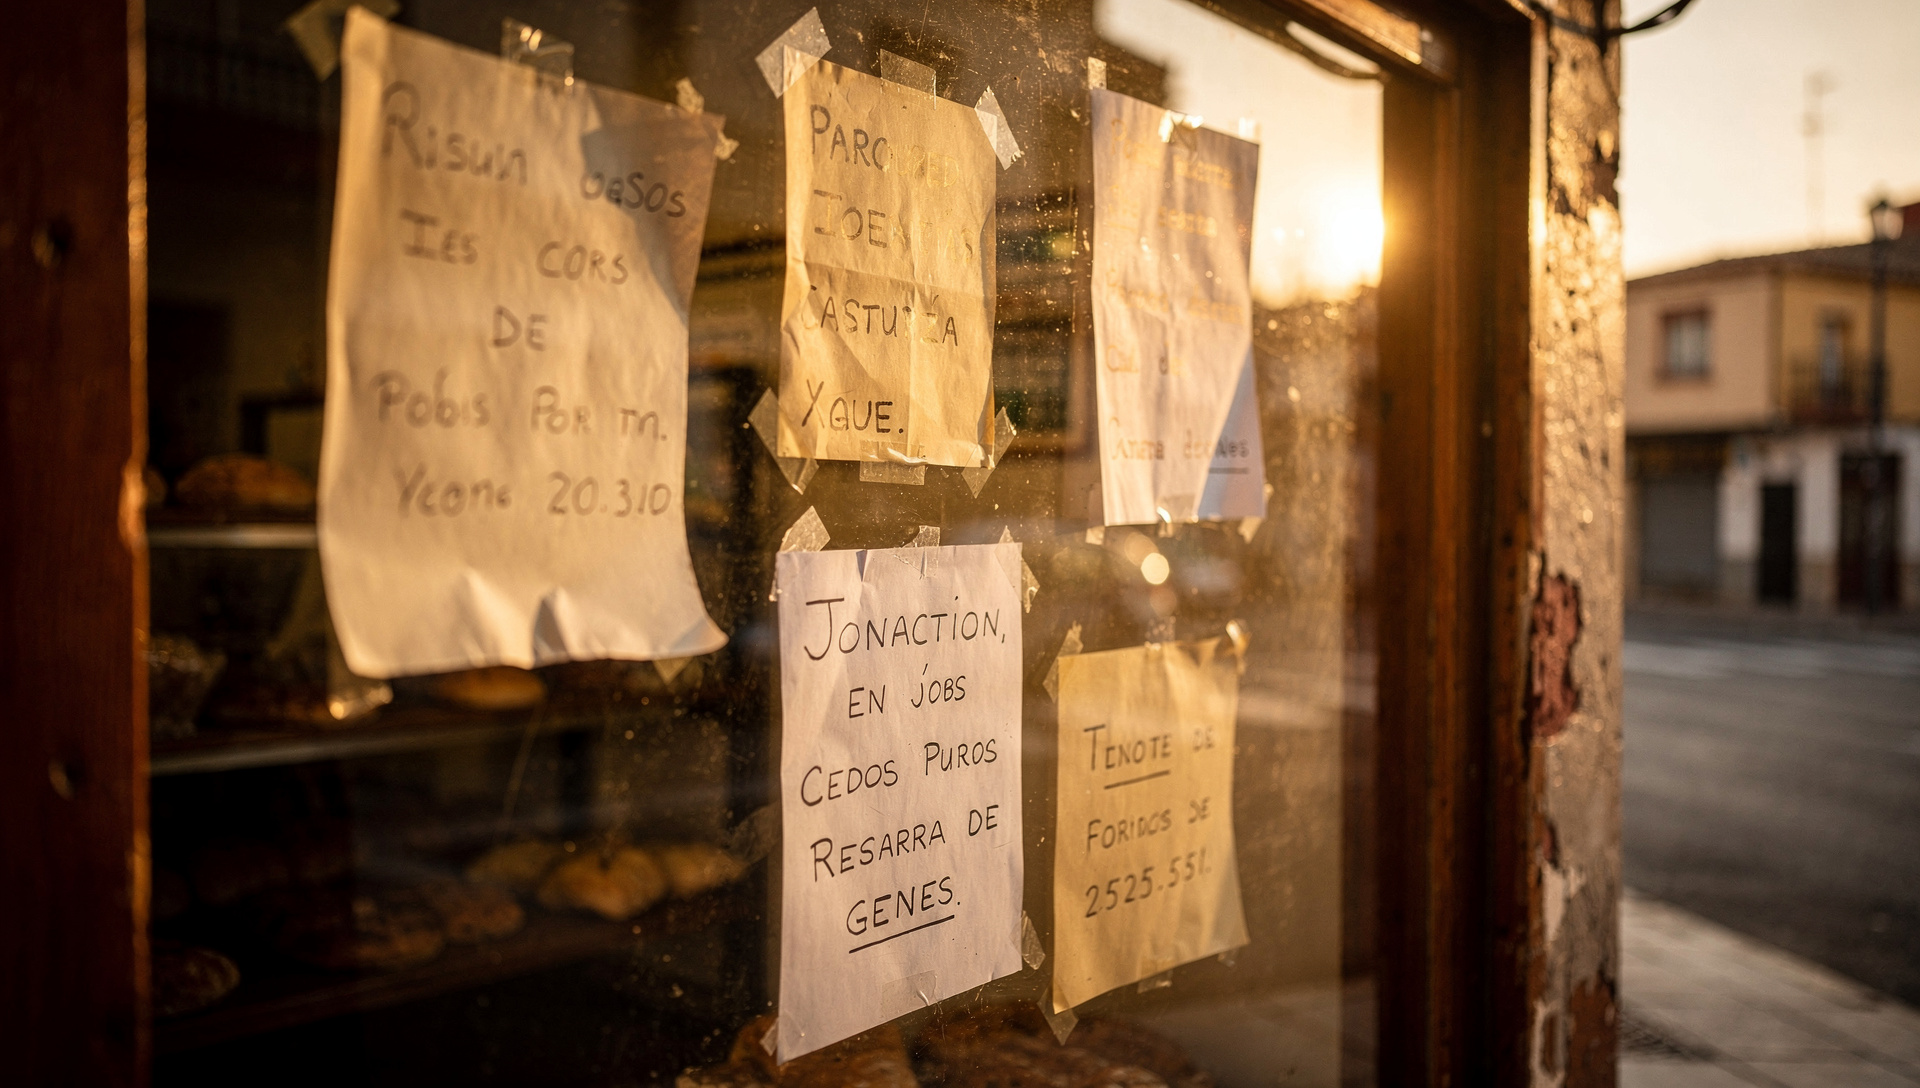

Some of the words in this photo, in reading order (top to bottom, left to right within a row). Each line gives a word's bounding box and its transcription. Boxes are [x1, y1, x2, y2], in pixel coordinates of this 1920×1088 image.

[492, 306, 549, 351] DE
[546, 470, 672, 518] 20.310
[849, 684, 886, 719] EN
[801, 760, 899, 807] CEDOS
[923, 738, 998, 776] PUROS
[810, 820, 946, 883] RESARRA
[968, 804, 999, 837] DE
[847, 875, 961, 936] GENES.
